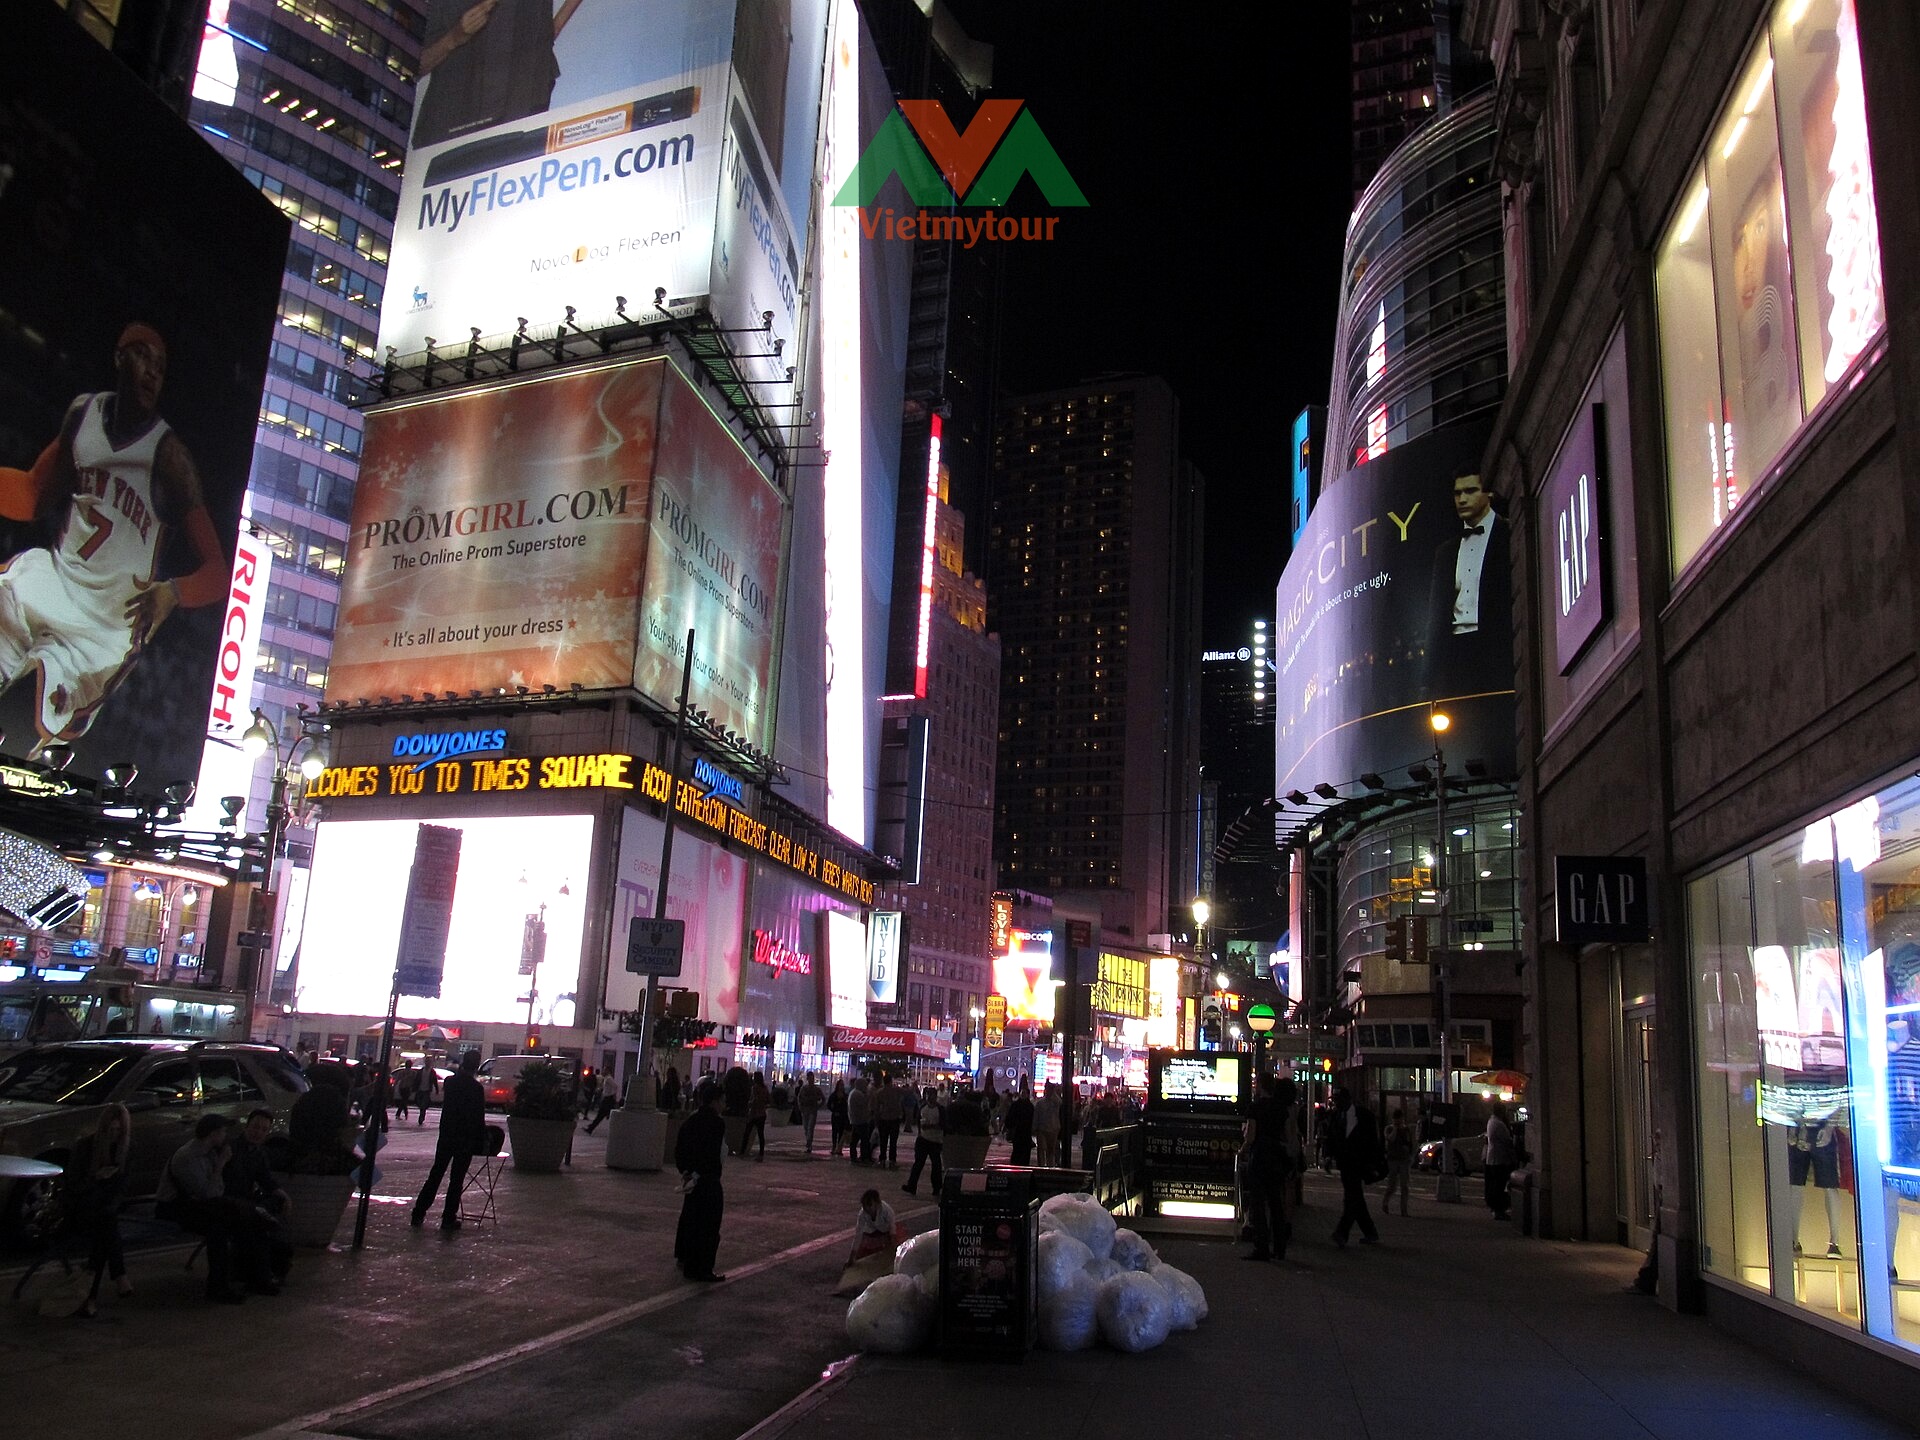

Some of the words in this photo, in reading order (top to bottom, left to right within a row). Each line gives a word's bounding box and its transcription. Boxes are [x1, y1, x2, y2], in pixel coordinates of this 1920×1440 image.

[418, 132, 694, 232] MyFlexPen.com
[641, 306, 693, 323] SHEROOD
[113, 477, 152, 545] YORK
[77, 505, 113, 561] 7
[393, 555, 416, 570] The
[420, 548, 463, 567] Online
[467, 544, 503, 560] Prom
[507, 533, 586, 556] Superstore
[1559, 474, 1590, 617] GAP
[674, 547, 687, 571] The
[688, 559, 709, 591] Online
[709, 580, 725, 605] Prom
[725, 595, 754, 633] Superstore
[1279, 570, 1313, 648] MAGIC
[1318, 503, 1420, 584] CITY
[1343, 590, 1352, 600] to
[1354, 582, 1367, 597] get
[1370, 572, 1391, 588] ugly.
[212, 547, 258, 723] RICOH
[394, 631, 414, 647] It's
[418, 627, 435, 645] all
[437, 624, 480, 643] about
[483, 622, 518, 643] your
[521, 617, 563, 636] dress
[649, 615, 666, 642] Your
[666, 634, 685, 659] style
[691, 649, 709, 677] Your
[708, 666, 725, 688] color
[730, 679, 744, 702] Your
[744, 689, 760, 715] dress
[1202, 651, 1236, 661] Allianz
[389, 763, 425, 795] YOU
[436, 762, 461, 792] TO
[471, 758, 531, 792] TIMES
[539, 754, 634, 789] SQUARE
[641, 762, 728, 832] ACCUEATHER.COM
[793, 843, 808, 872] LOW
[808, 852, 819, 878] 54
[859, 879, 874, 905] NEWS
[1203, 797, 1214, 852] TIMES
[1569, 872, 1634, 924] GAP
[641, 921, 674, 934] NYPD
[633, 944, 678, 957] SECURITY
[633, 954, 674, 967] CAMERA
[754, 928, 811, 980] Walgreens
[877, 917, 890, 980] NYPD
[833, 1029, 905, 1048] Walgreens
[1147, 1136, 1173, 1146] Times
[1177, 1137, 1208, 1148] Square
[1161, 1146, 1171, 1154] St
[1175, 1146, 1208, 1156] Station
[955, 1225, 984, 1235] START
[957, 1236, 982, 1245] YOUR
[957, 1246, 982, 1256] VISIT
[957, 1257, 981, 1267] HERE
